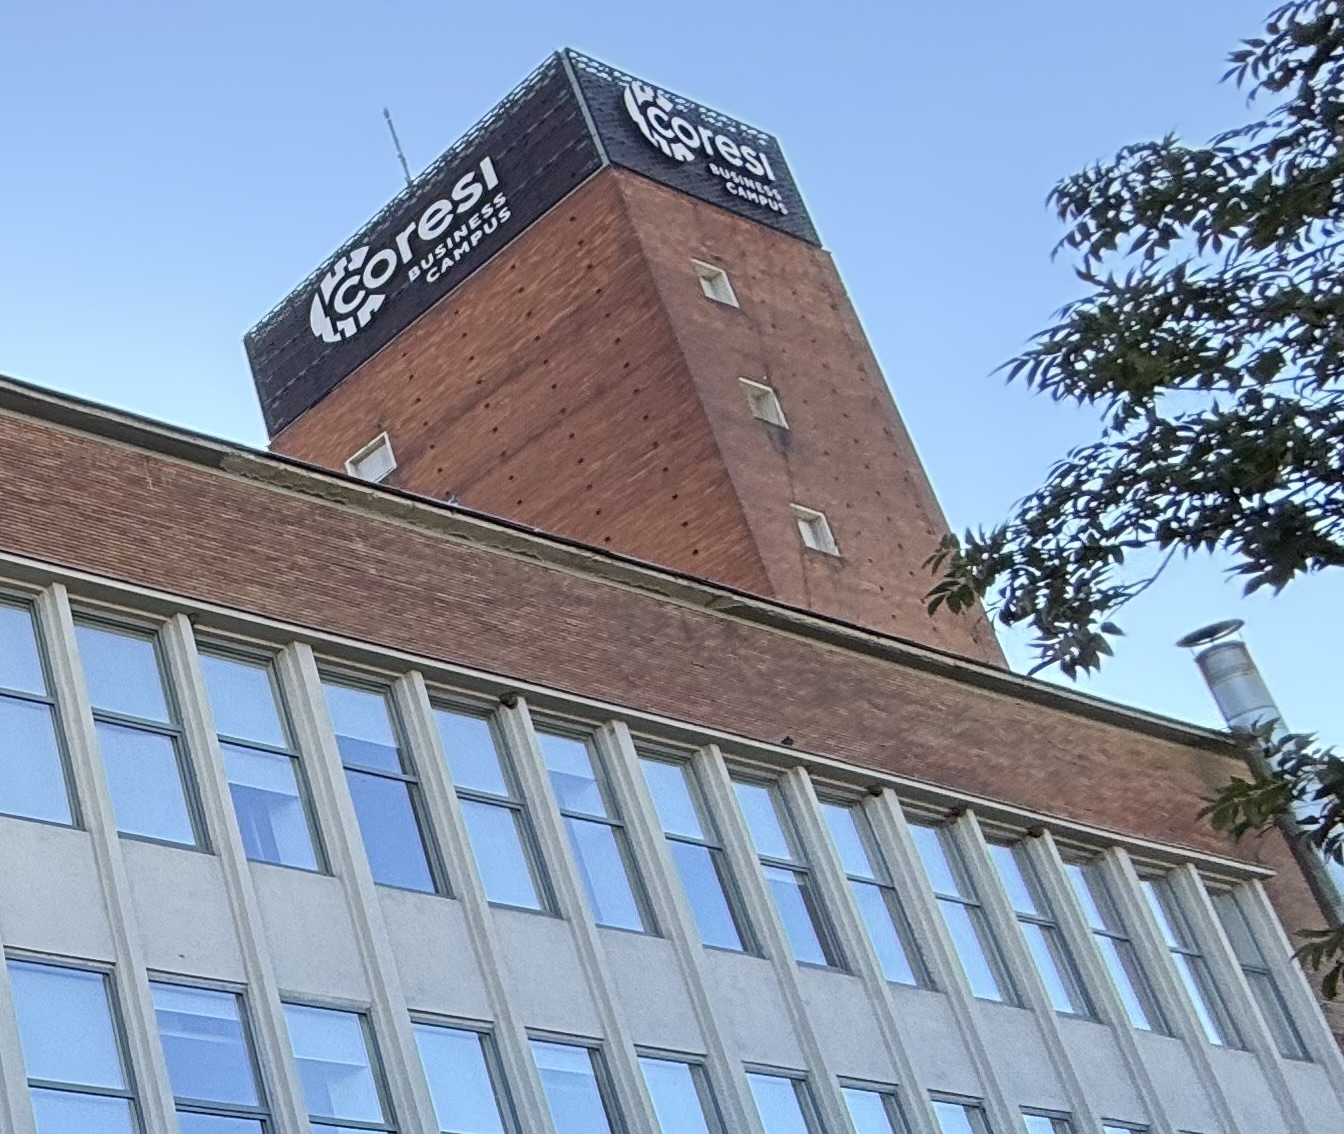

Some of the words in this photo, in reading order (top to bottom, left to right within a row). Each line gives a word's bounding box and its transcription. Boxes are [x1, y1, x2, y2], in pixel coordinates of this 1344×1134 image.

[709, 163, 783, 201] BUSINESS
[726, 181, 789, 215] CAMPUS
[408, 191, 507, 283] BUSINESS
[426, 206, 512, 283] CAMPUS
